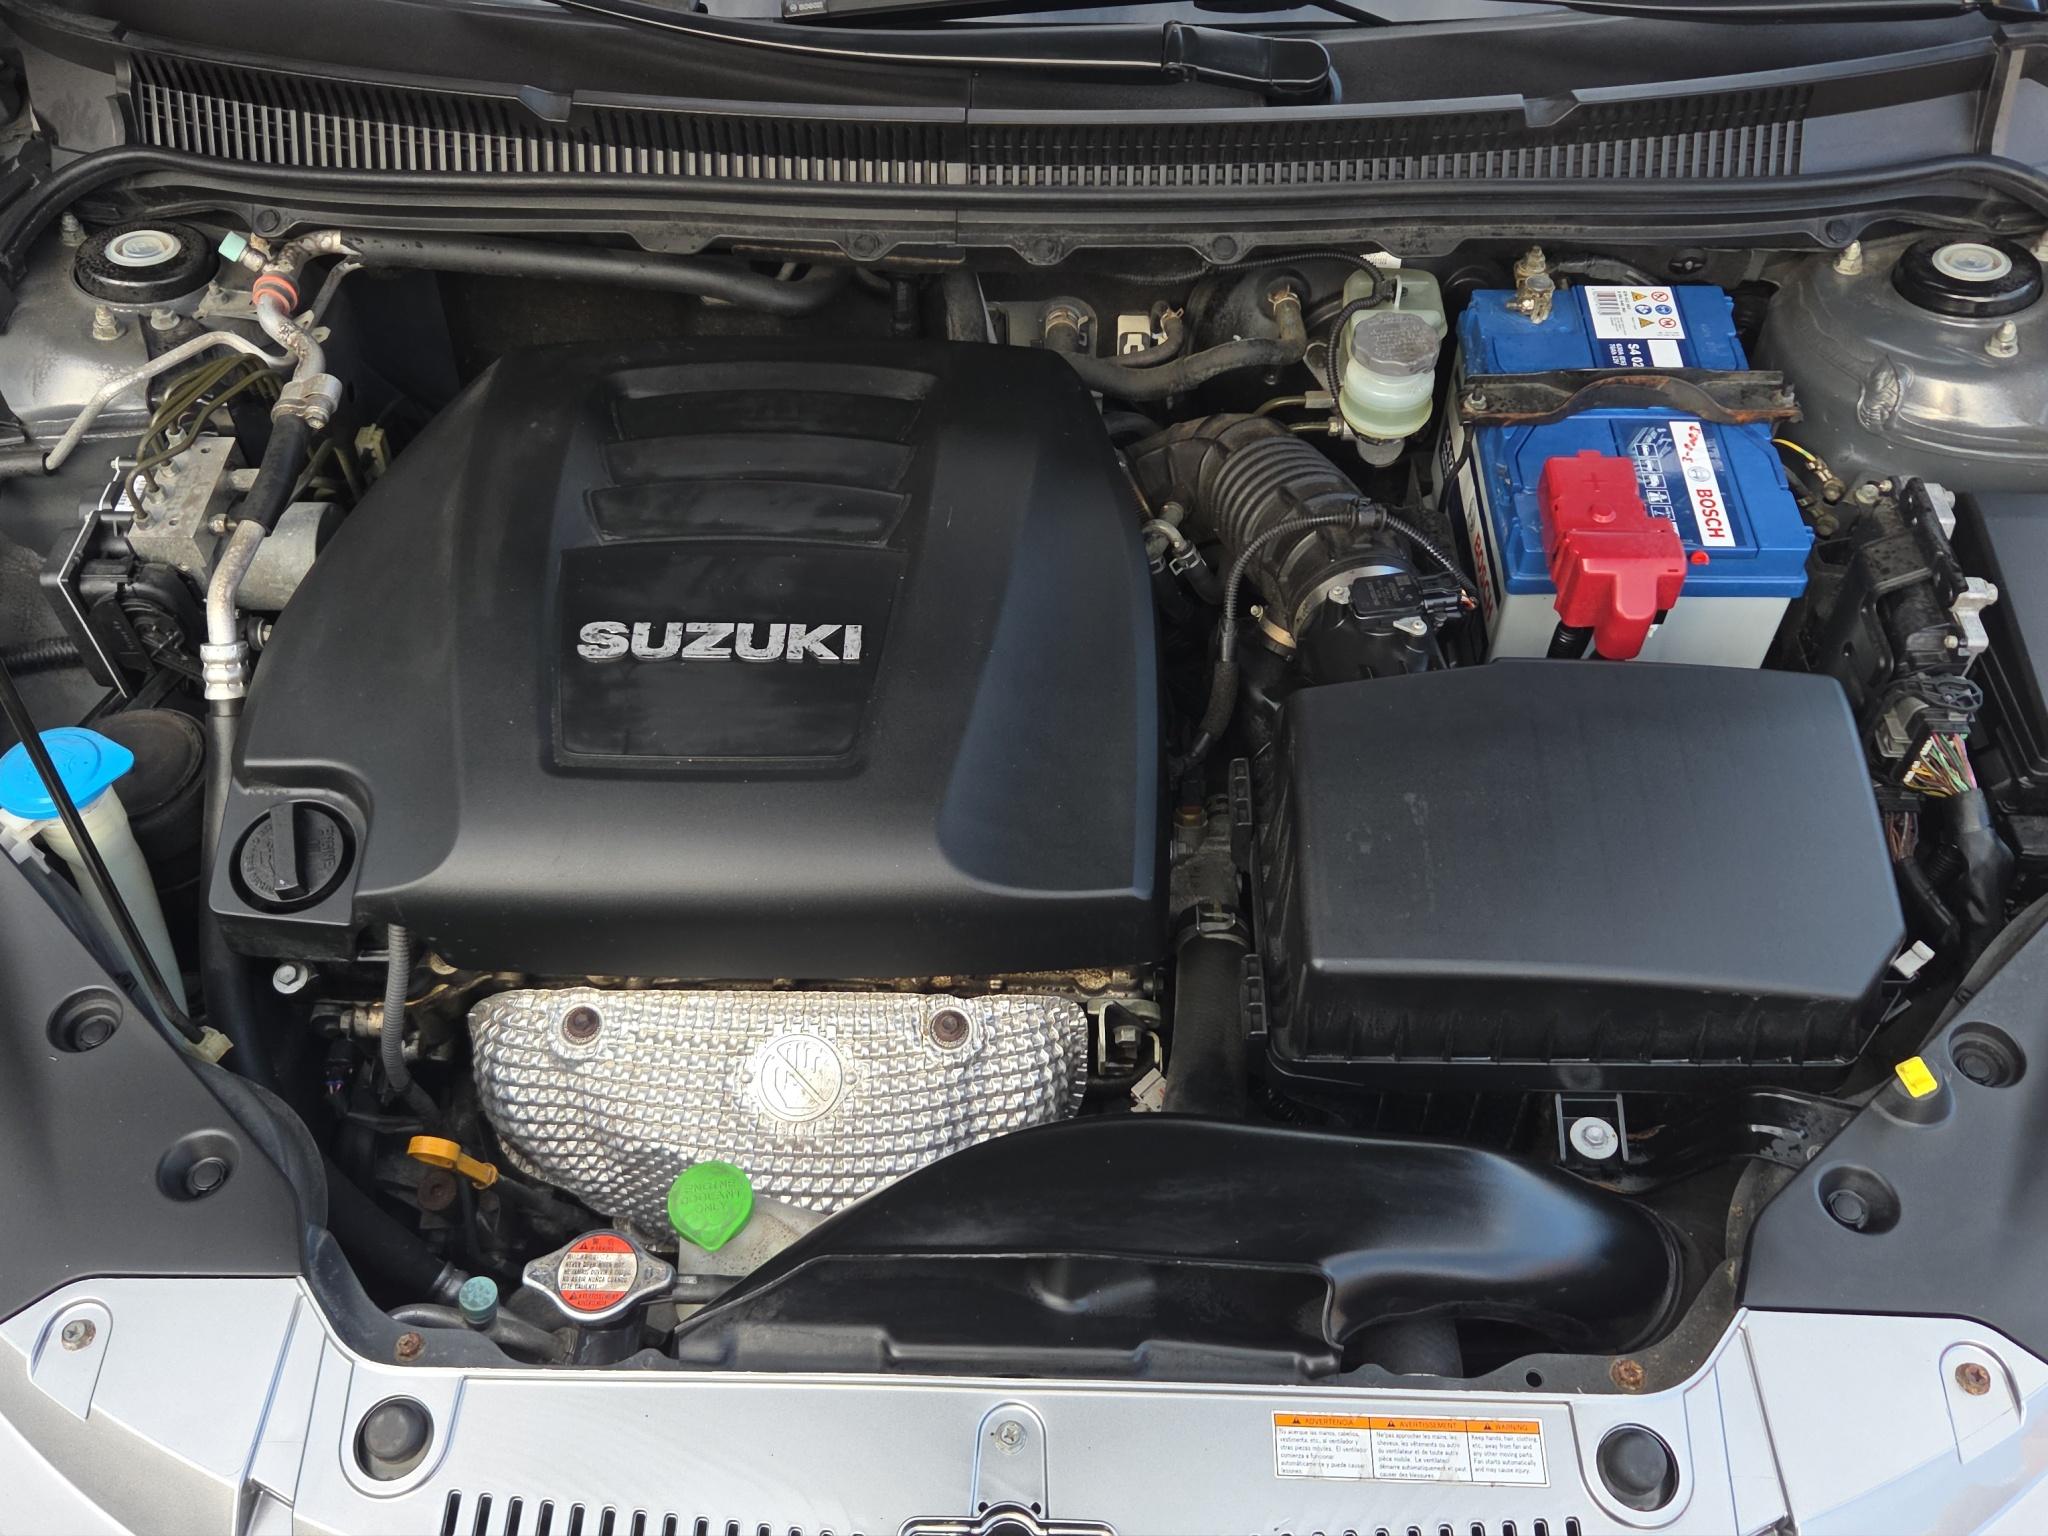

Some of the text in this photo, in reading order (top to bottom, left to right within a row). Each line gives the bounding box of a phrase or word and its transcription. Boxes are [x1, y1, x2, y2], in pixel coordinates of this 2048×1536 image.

[1628, 343, 1640, 356] S4
[1696, 488, 1725, 538] BOSCH
[1474, 533, 1494, 622] BOSCH
[577, 621, 862, 661] SUZUKI
[685, 1180, 735, 1193] ENGINE
[681, 1190, 740, 1205] COOLANT
[696, 1202, 727, 1213] ONLY
